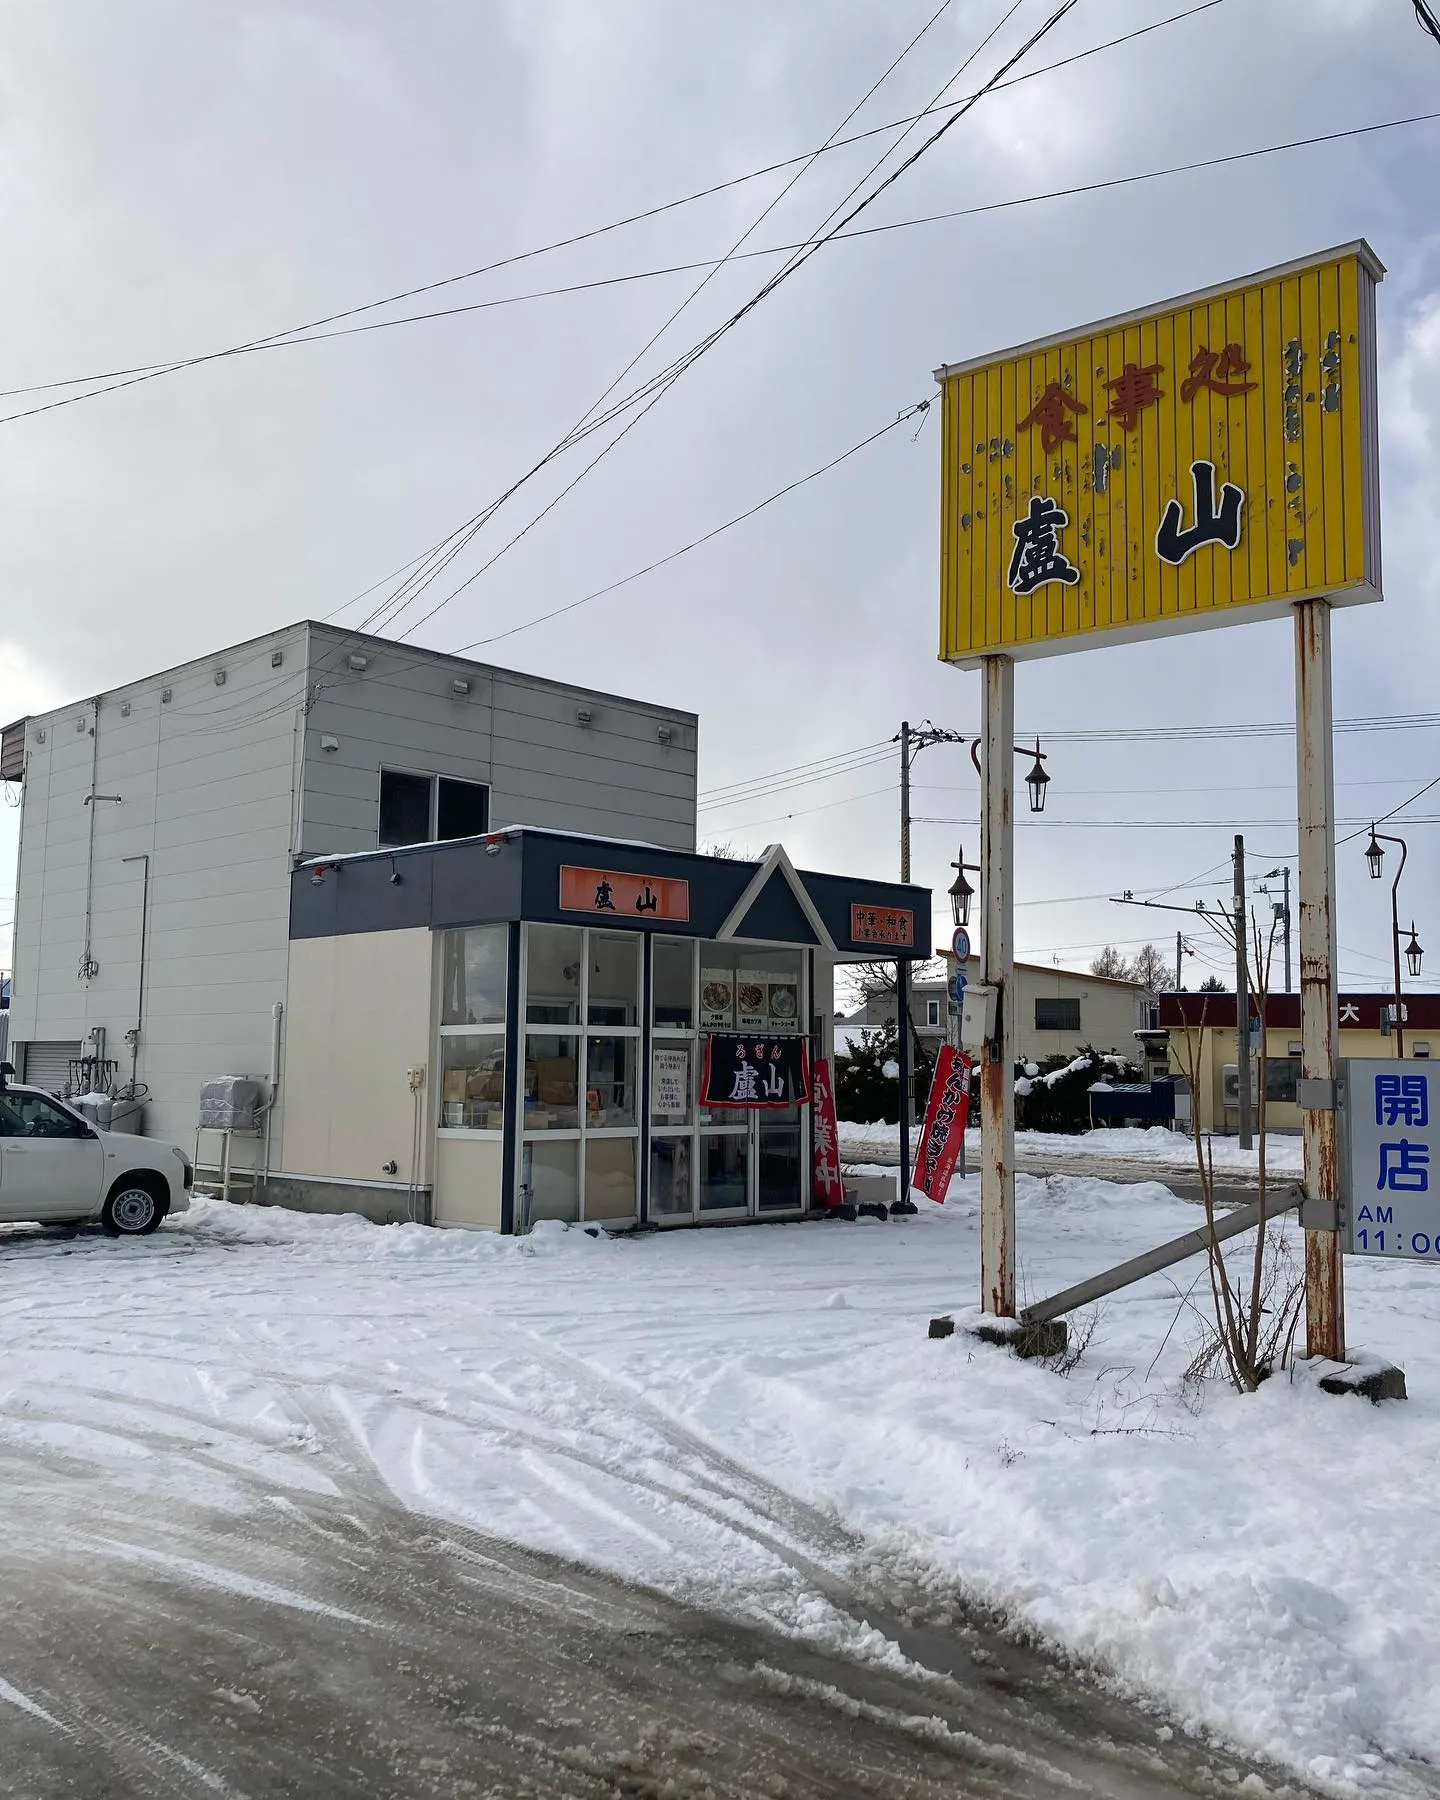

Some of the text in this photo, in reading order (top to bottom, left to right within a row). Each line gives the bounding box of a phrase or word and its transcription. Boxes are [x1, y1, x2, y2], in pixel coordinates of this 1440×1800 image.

[1016, 344, 1258, 454] 食事処
[957, 938, 967, 954] 40
[735, 1043, 782, 1060] ろざん
[1375, 1074, 1430, 1192] 開店
[1358, 1205, 1393, 1224] AM
